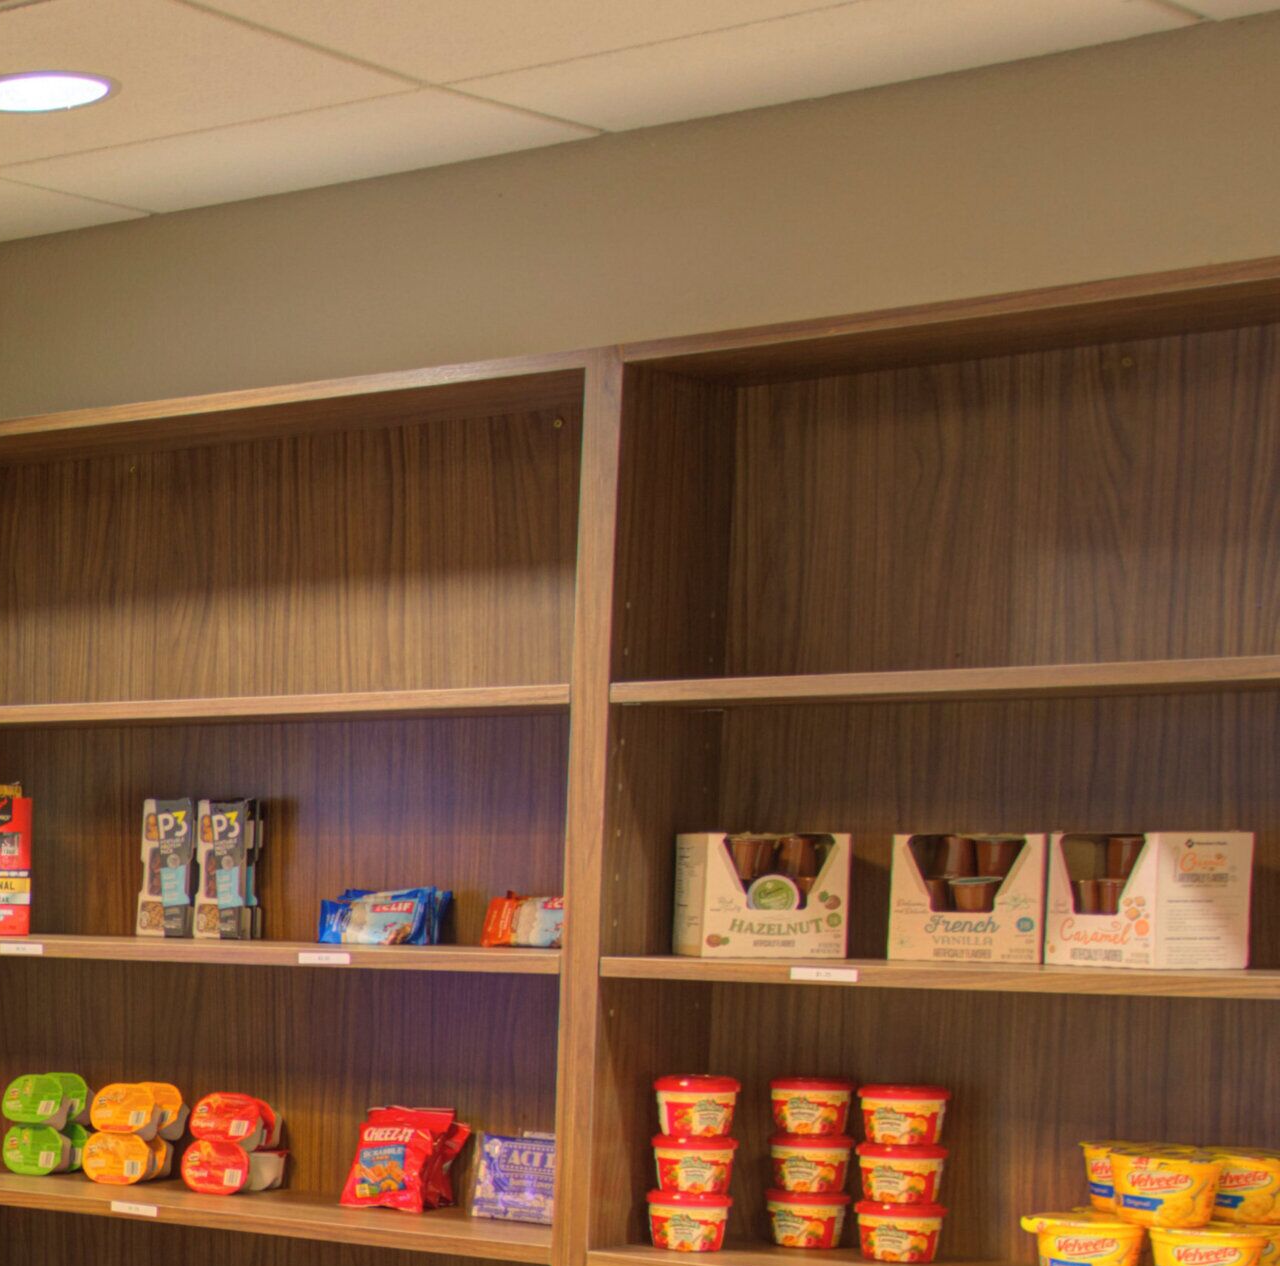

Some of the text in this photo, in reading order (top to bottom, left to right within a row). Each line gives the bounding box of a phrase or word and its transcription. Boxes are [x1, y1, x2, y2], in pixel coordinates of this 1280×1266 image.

[158, 810, 188, 840] P3
[212, 810, 241, 840] P3
[729, 917, 823, 936] HAZELNUT
[925, 914, 1001, 934] French
[1059, 917, 1133, 946] Caramel
[931, 935, 993, 946] VANILLA
[507, 1151, 534, 1168] ACT
[1129, 1173, 1190, 1189] Velveeta
[1218, 1170, 1269, 1187] elveeta
[1056, 1236, 1118, 1252] Velveeta
[1175, 1246, 1239, 1261] Velveeta
